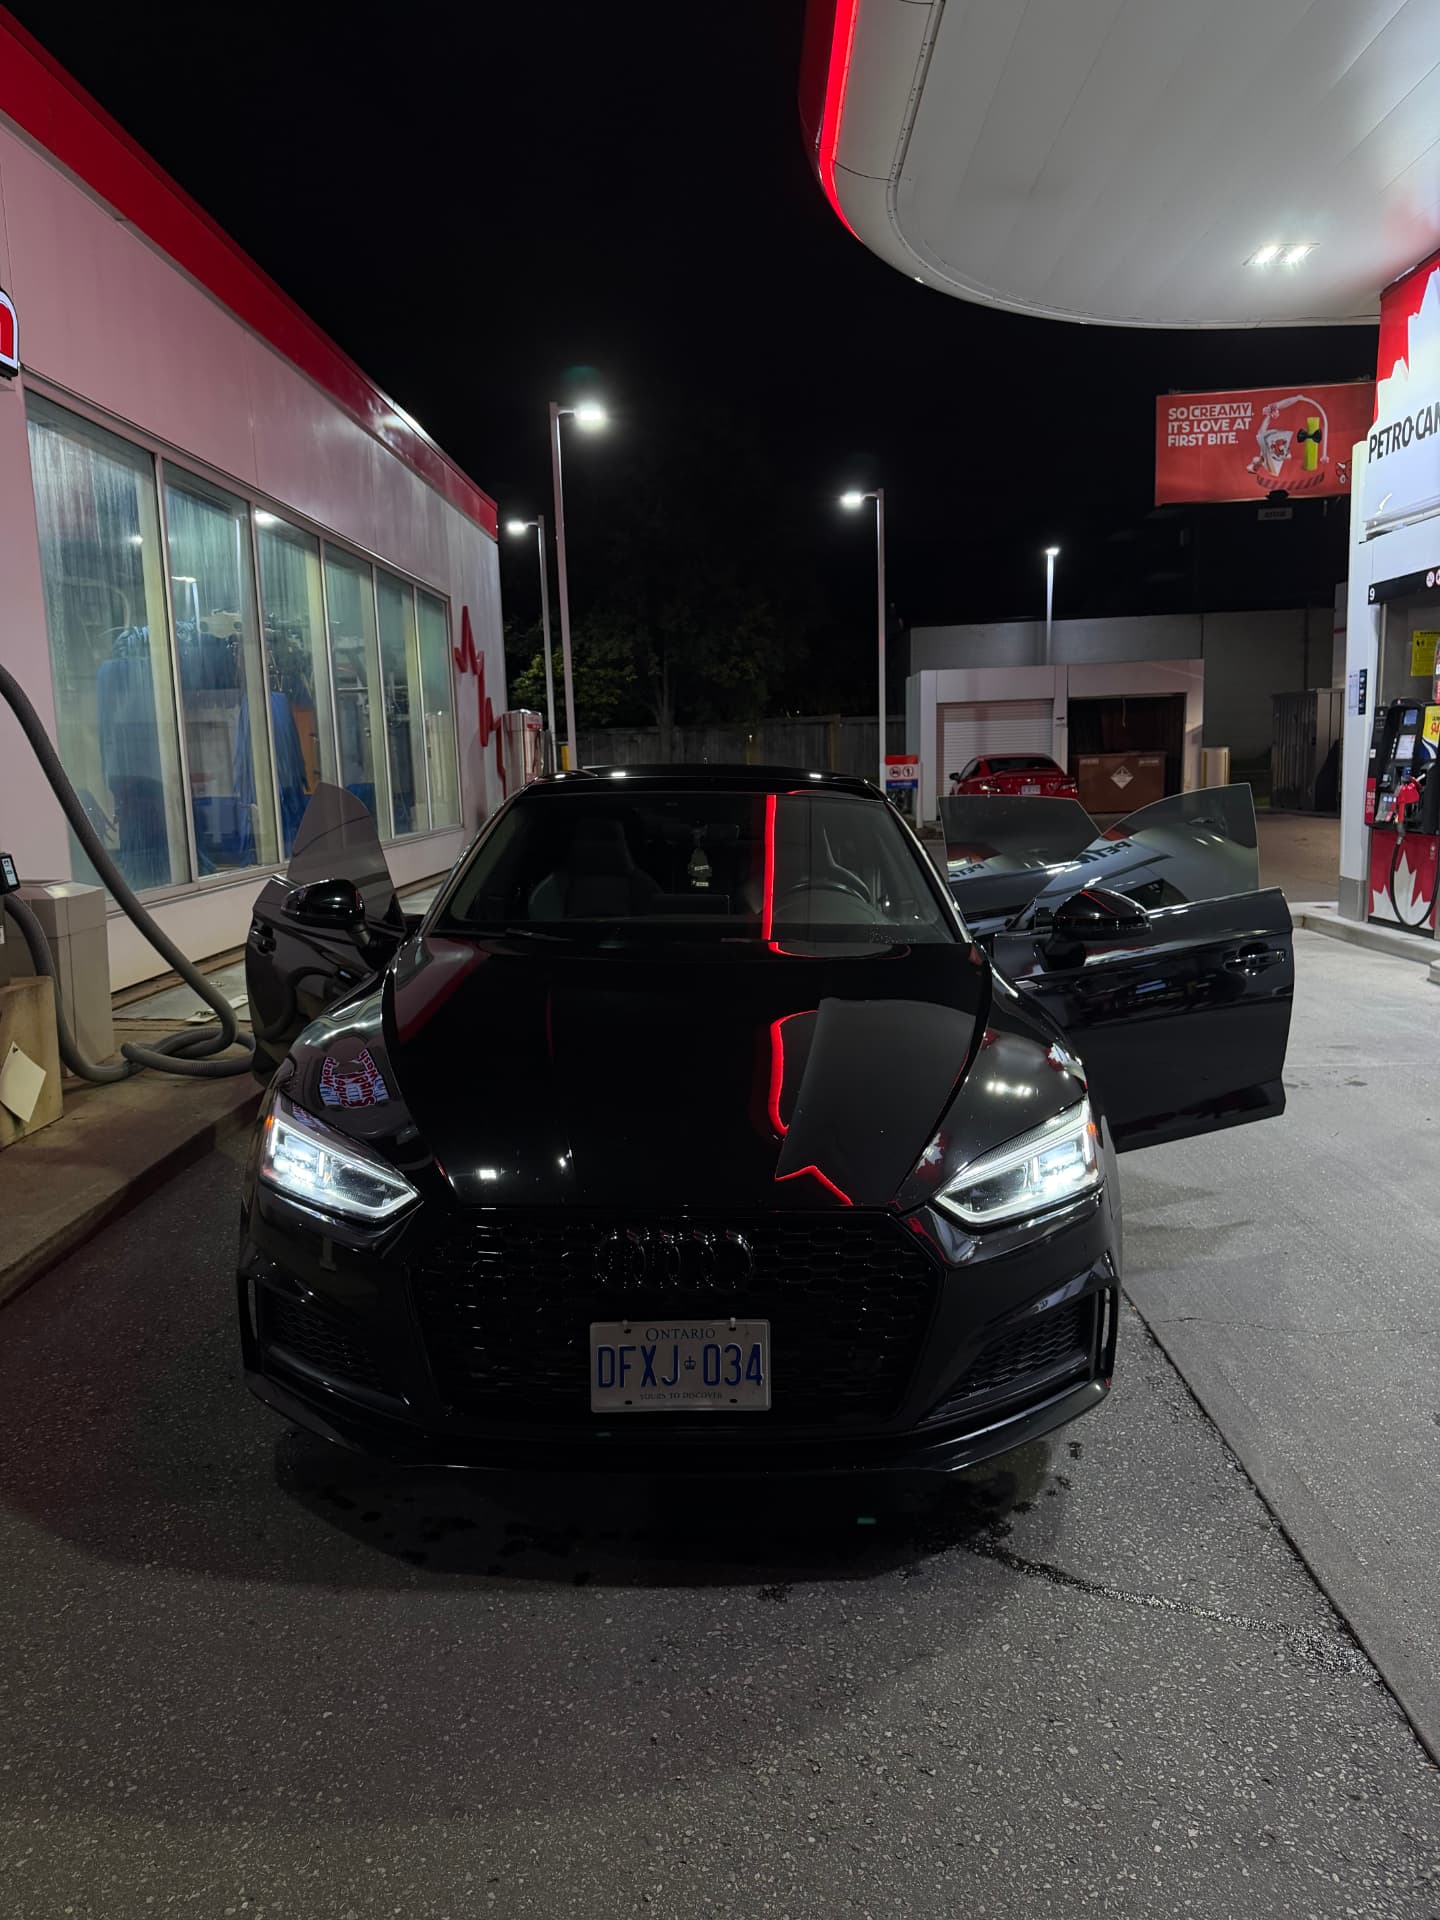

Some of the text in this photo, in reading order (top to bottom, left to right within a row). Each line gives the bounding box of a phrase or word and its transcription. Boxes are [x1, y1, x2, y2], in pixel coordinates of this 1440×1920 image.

[1168, 403, 1254, 420] SO CREAMY.
[1168, 418, 1252, 434] IT'S LOVE AT
[1168, 432, 1239, 447] FIRST BITE.
[1369, 587, 1376, 601] 9
[645, 1327, 716, 1342] ONTARIO
[598, 1343, 764, 1388] DFXJ 034
